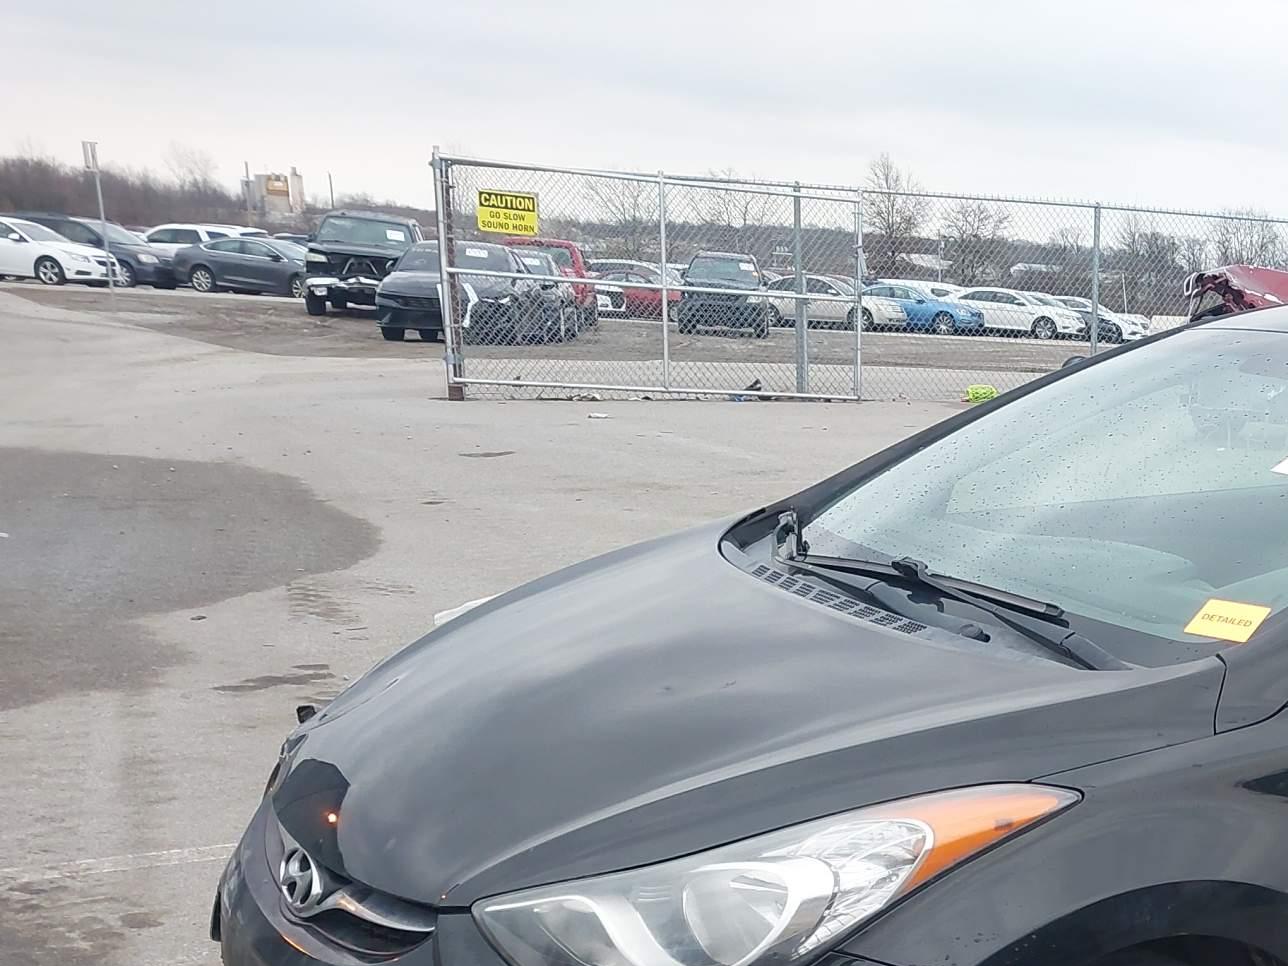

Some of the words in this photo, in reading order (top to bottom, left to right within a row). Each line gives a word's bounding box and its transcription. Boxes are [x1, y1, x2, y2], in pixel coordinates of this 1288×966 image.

[480, 193, 534, 211] CAUTION
[489, 211, 501, 219] GO
[503, 212, 526, 222] SLOW
[481, 220, 510, 231] SOUND
[512, 223, 535, 233] HORN
[1201, 613, 1253, 627] DETAILED
